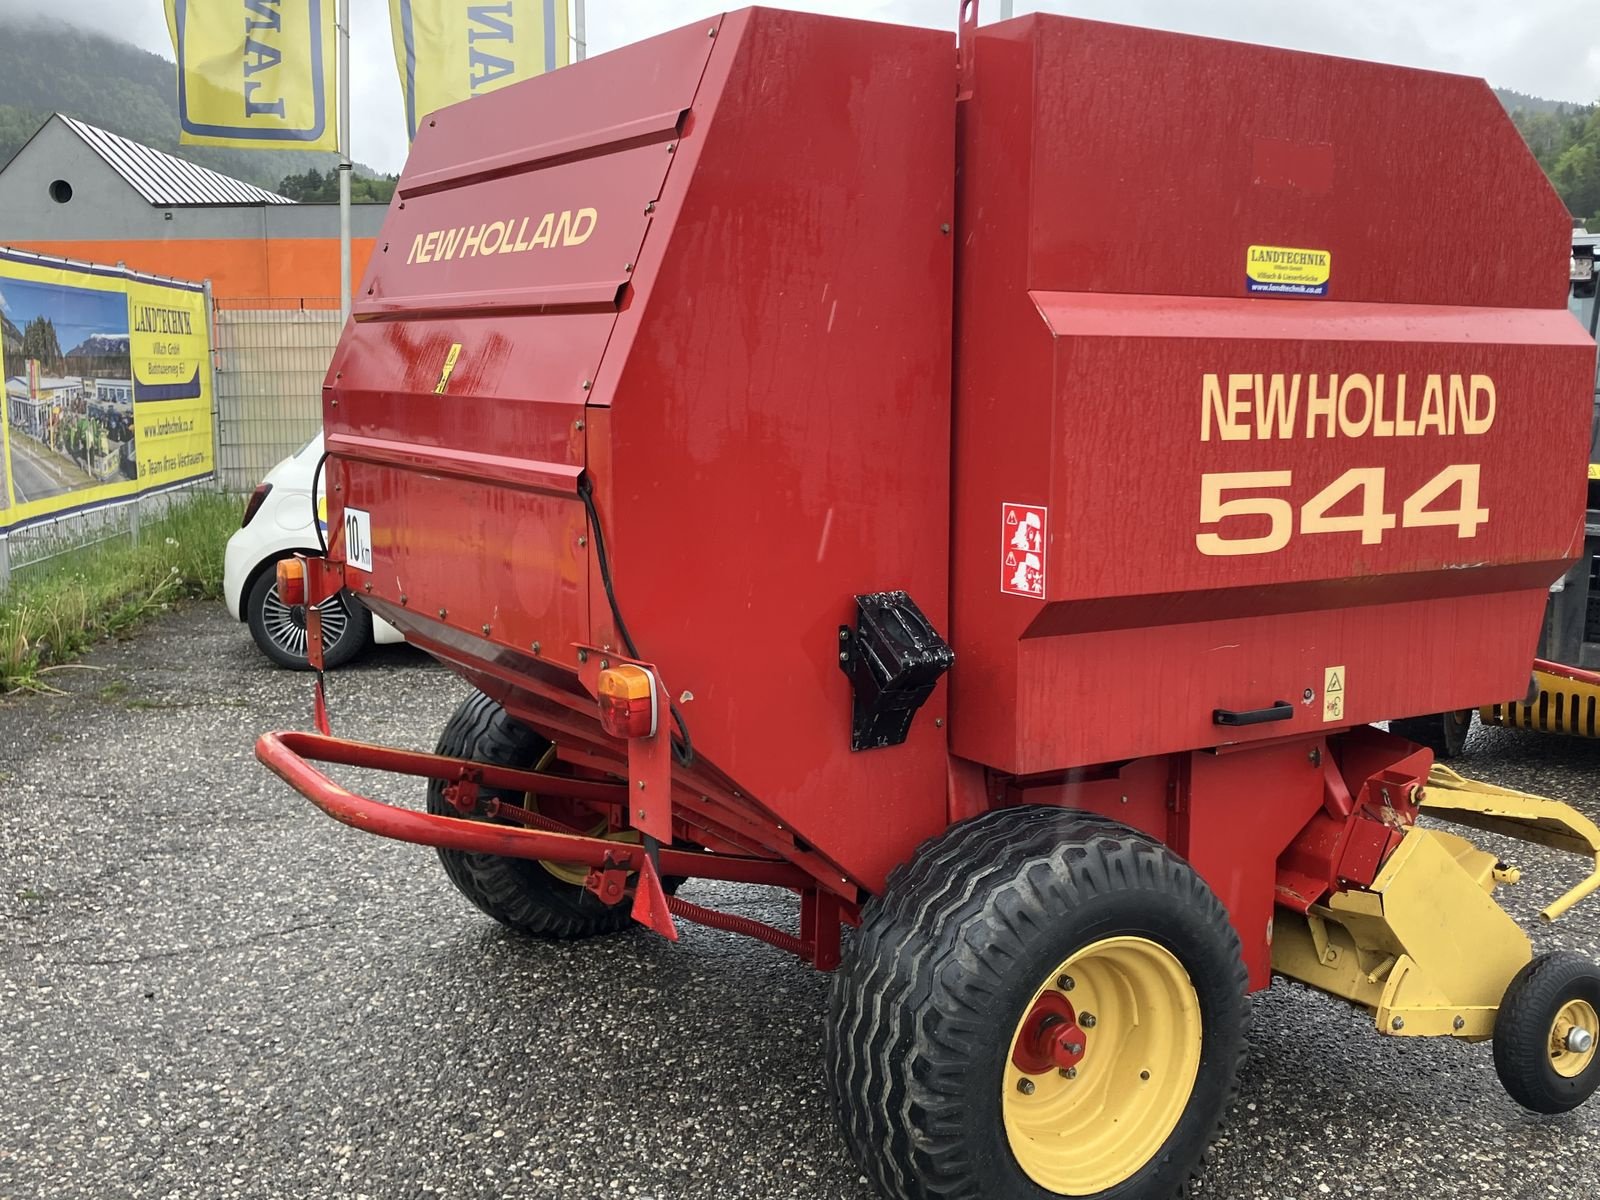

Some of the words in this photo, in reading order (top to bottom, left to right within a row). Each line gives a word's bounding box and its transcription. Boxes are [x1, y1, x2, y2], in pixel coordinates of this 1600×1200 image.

[406, 227, 465, 264] NEW
[459, 207, 598, 259] HOLLAND
[1251, 249, 1327, 267] LANDTECHNIK
[134, 305, 193, 335] LANDTECHNIK
[1200, 373, 1302, 441] NEW
[1306, 373, 1497, 438] HOLLAND
[1195, 464, 1490, 557] 544
[346, 514, 360, 562] 10
